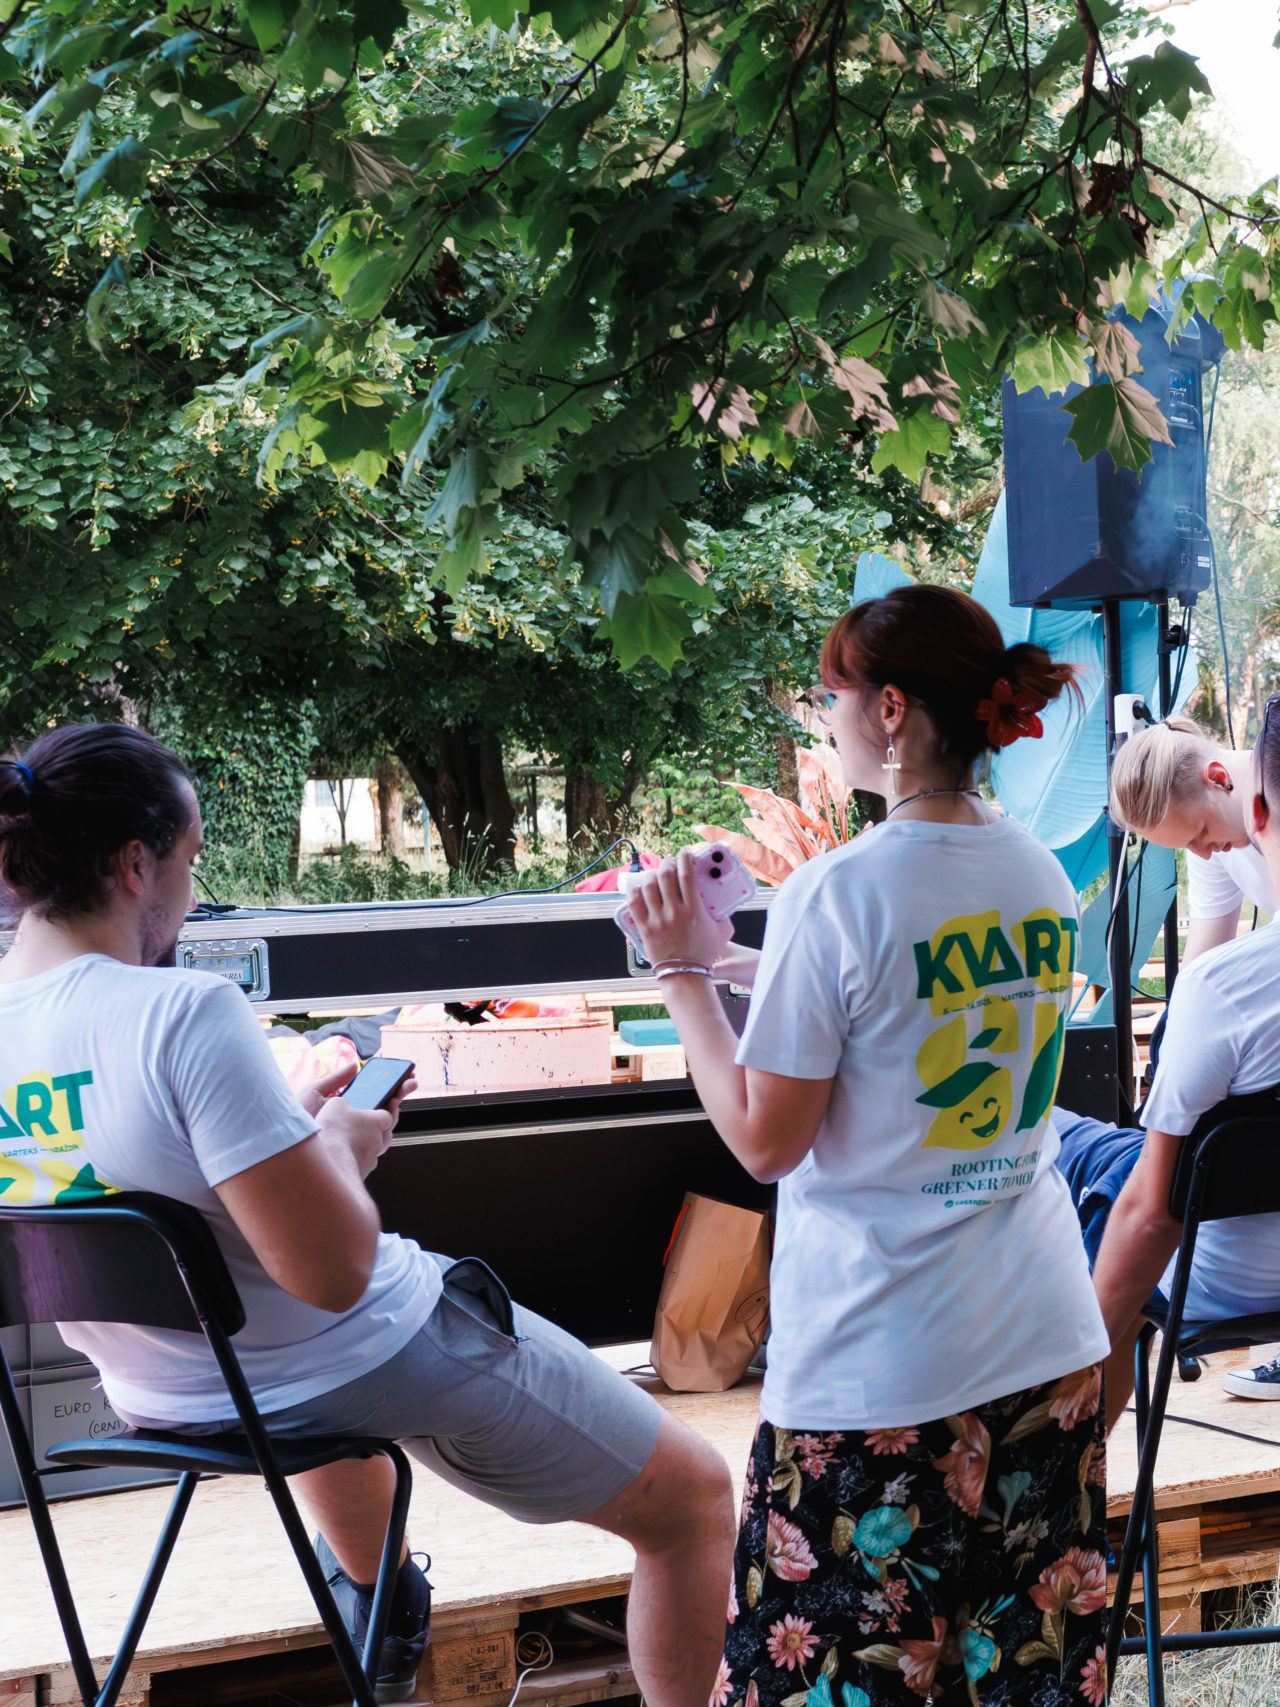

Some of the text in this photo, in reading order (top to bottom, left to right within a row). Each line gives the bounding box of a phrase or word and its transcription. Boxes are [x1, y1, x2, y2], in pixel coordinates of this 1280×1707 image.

[913, 917, 1079, 999] KVART
[951, 1155, 1021, 1177] ROOTING
[921, 1177, 998, 1195] GREENER
[54, 1402, 91, 1418] EURO
